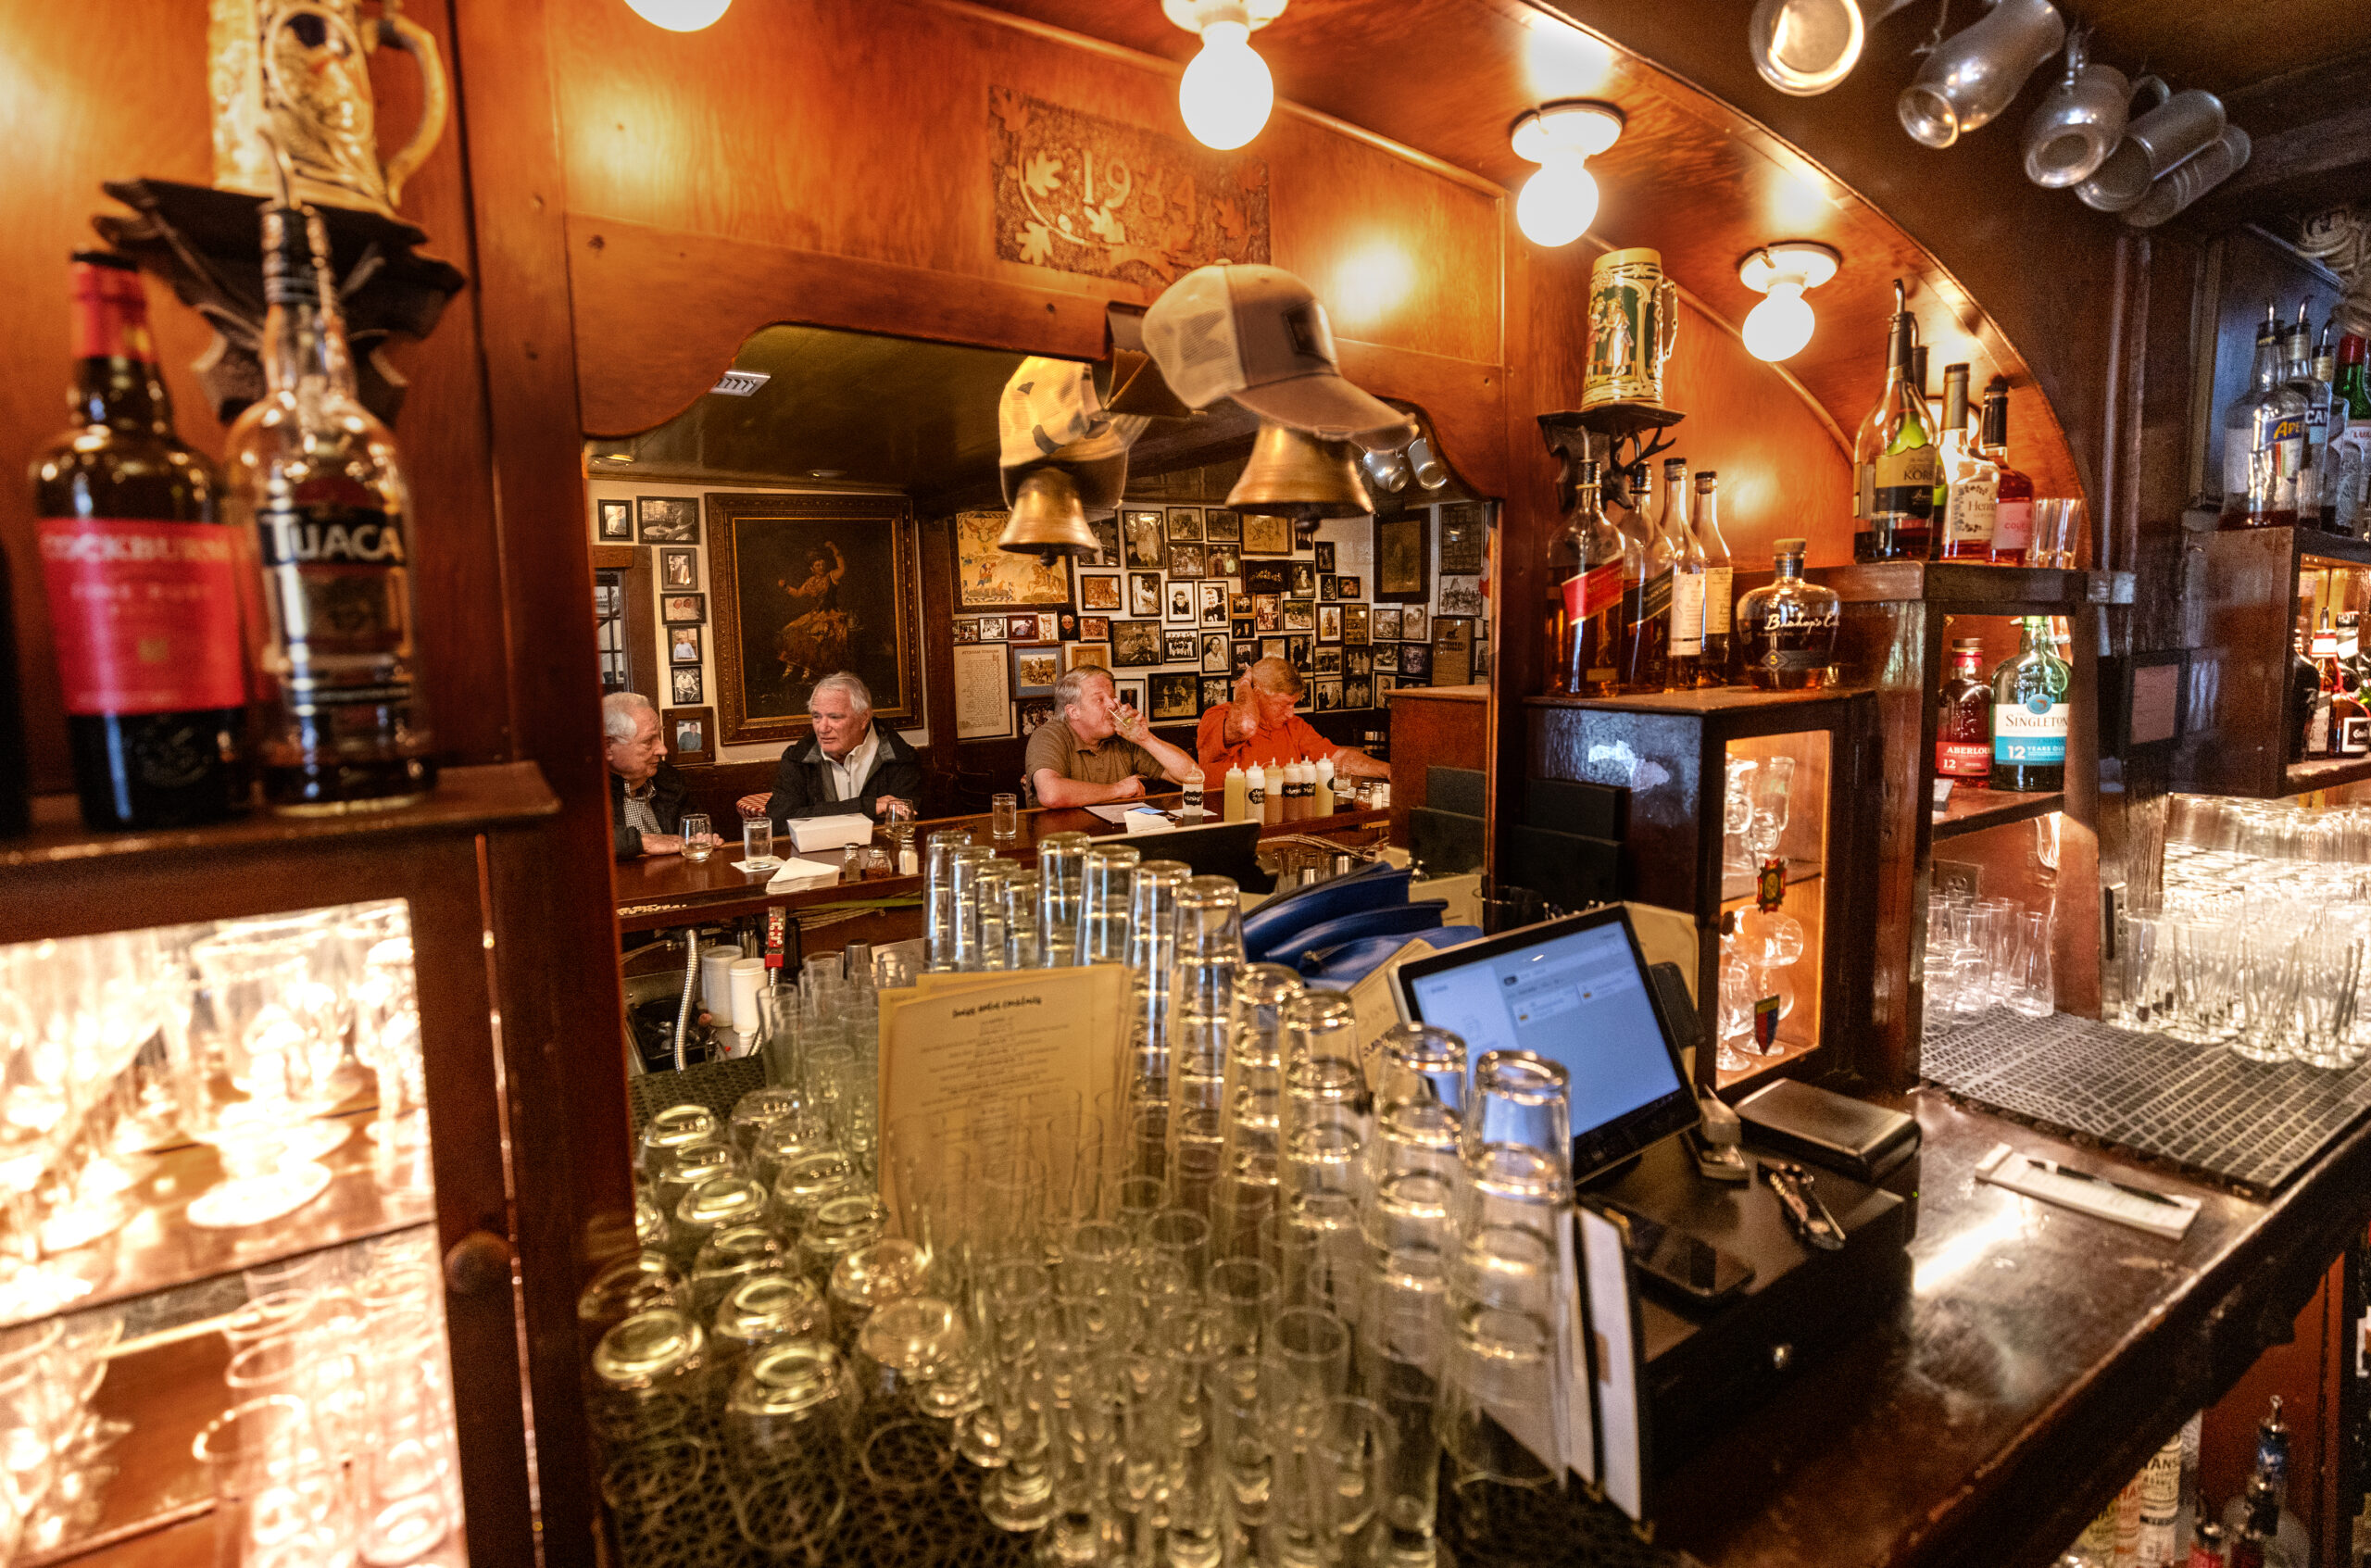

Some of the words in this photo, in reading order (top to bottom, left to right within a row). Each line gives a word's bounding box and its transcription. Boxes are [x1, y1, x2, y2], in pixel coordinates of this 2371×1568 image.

[260, 514, 405, 561] TUACA
[1770, 655, 1779, 665] 5
[2008, 745, 2026, 759] 12
[1943, 759, 1956, 769] 12
